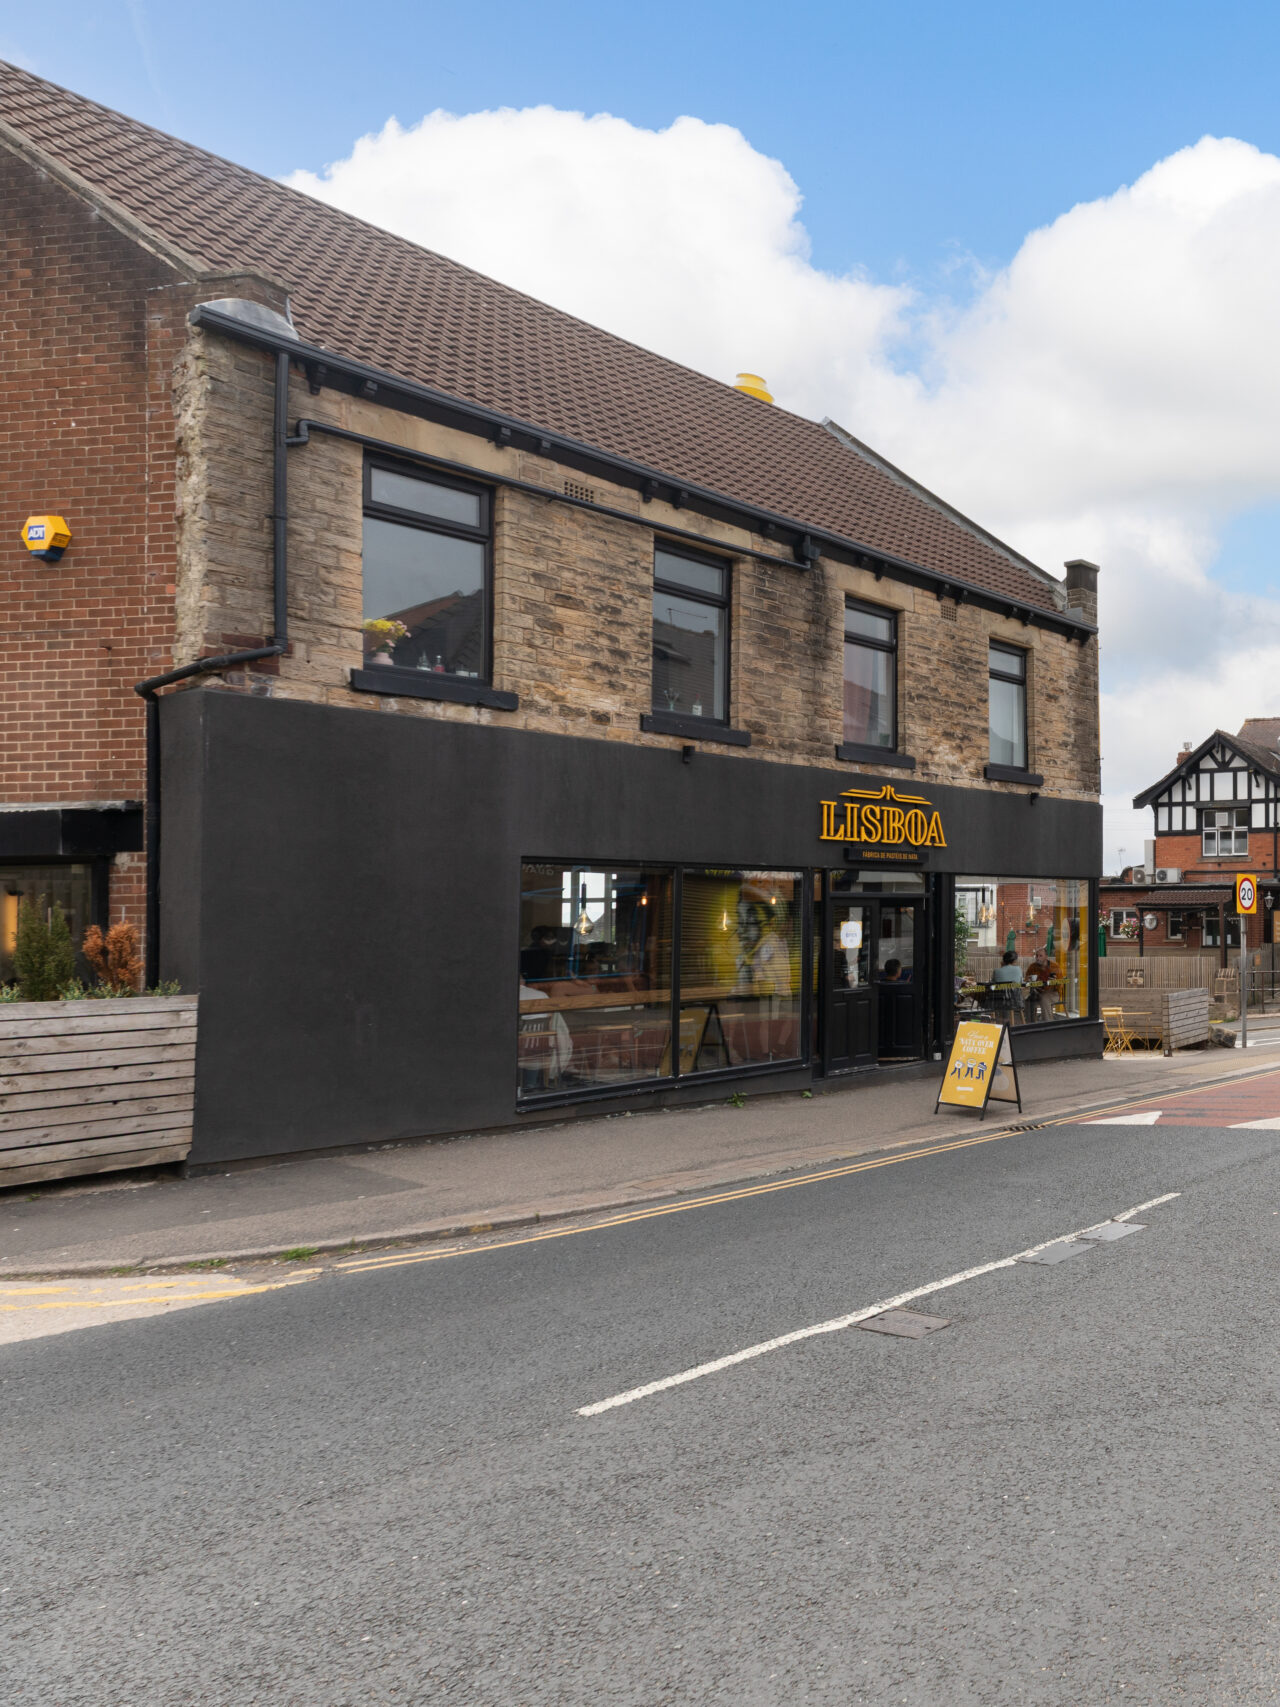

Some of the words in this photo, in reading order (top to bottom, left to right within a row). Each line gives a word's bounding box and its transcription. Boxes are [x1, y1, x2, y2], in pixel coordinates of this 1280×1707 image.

[28, 528, 45, 538] ADT
[819, 800, 948, 848] LISBOA
[1241, 888, 1252, 900] 20
